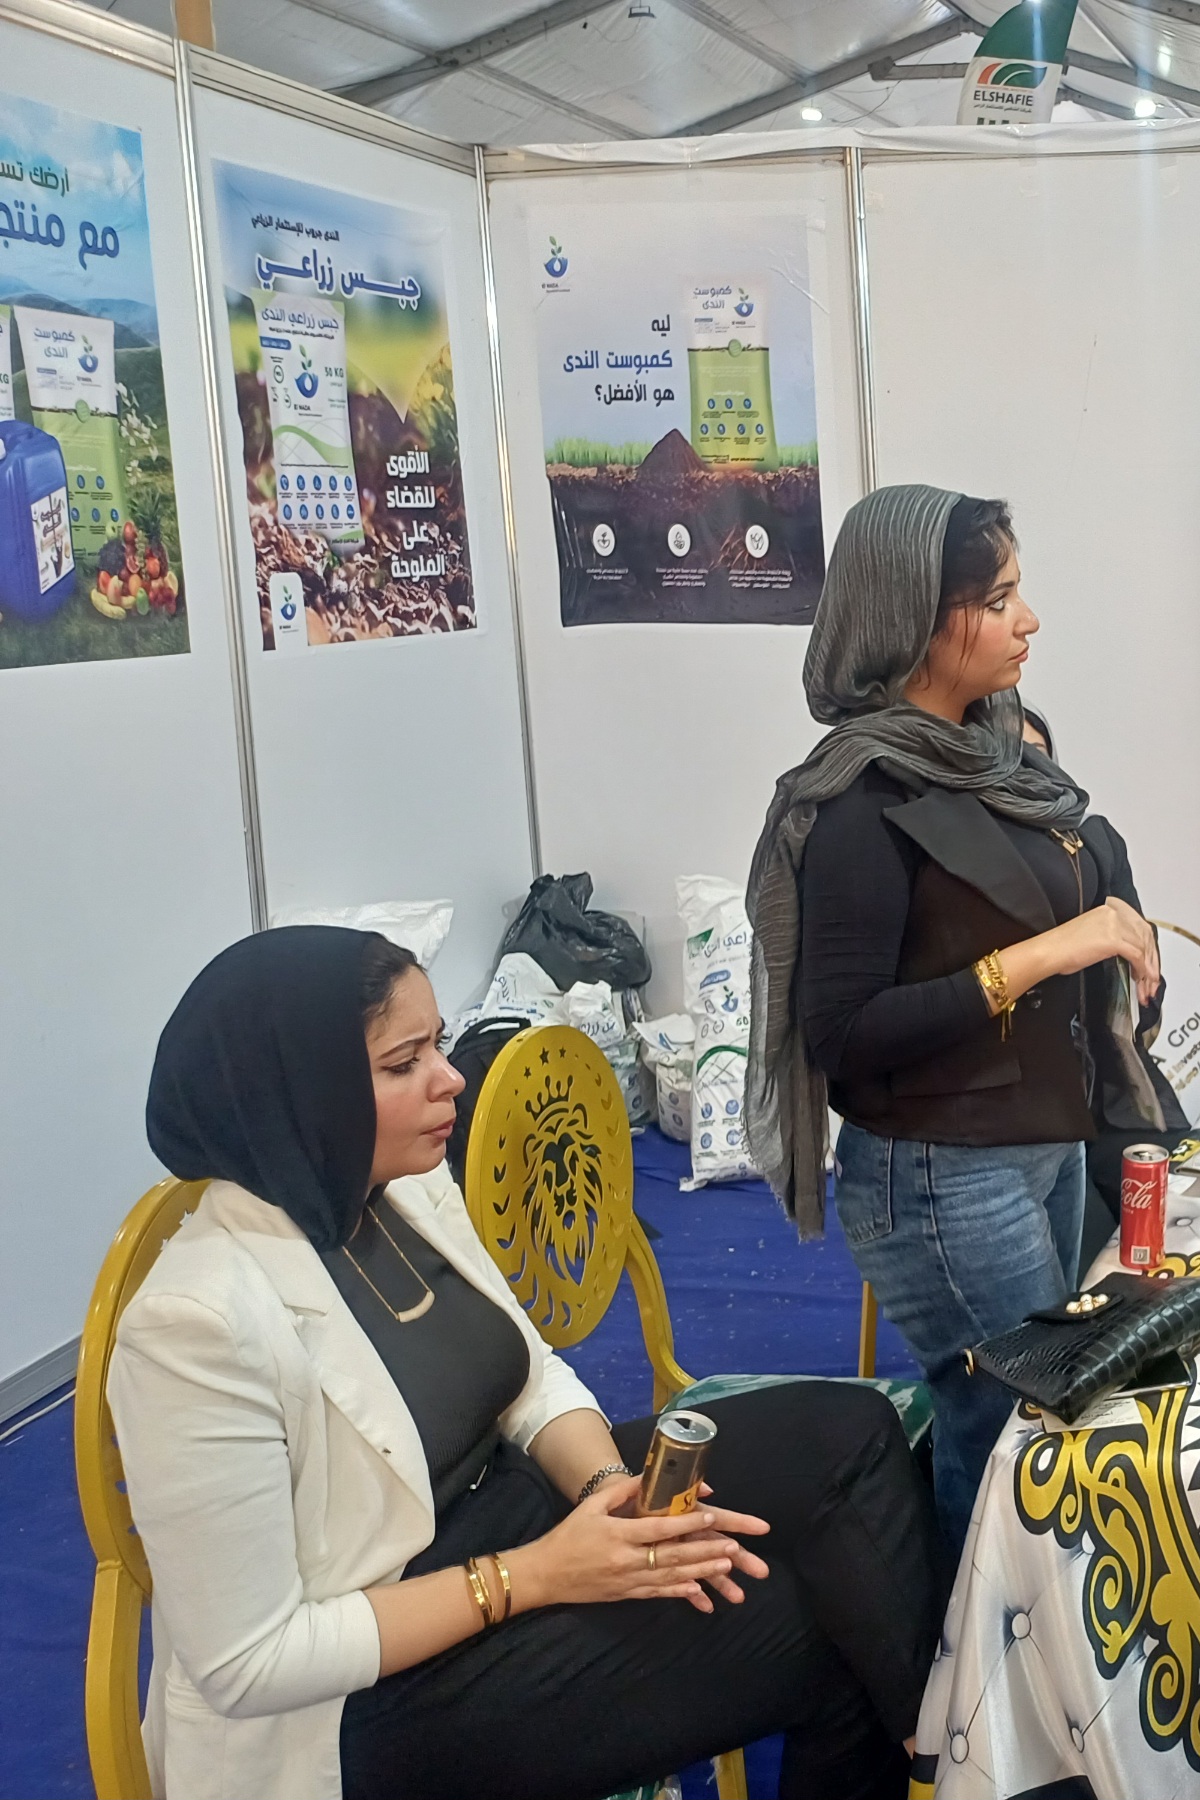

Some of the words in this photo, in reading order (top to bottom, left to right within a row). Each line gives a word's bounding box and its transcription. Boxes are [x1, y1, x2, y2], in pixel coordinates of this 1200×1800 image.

[973, 90, 1034, 107] ELSHAFIE
[29, 167, 70, 198] أرضك
[0, 199, 65, 249] منتج
[78, 221, 119, 271] مع
[257, 249, 335, 291] زراعي
[341, 270, 420, 310] جبس
[693, 286, 732, 298] كمبوست
[261, 308, 286, 322] الندى
[702, 299, 725, 310] الندى
[288, 312, 316, 329] زراعي
[652, 314, 671, 337] ليه
[563, 350, 599, 373] الندى
[606, 350, 673, 375] كمبوست
[595, 380, 647, 405] الأفضل؟
[653, 388, 675, 407] هو
[386, 445, 430, 478] الأقوى
[386, 485, 436, 508] للقضاء
[403, 520, 429, 550] على
